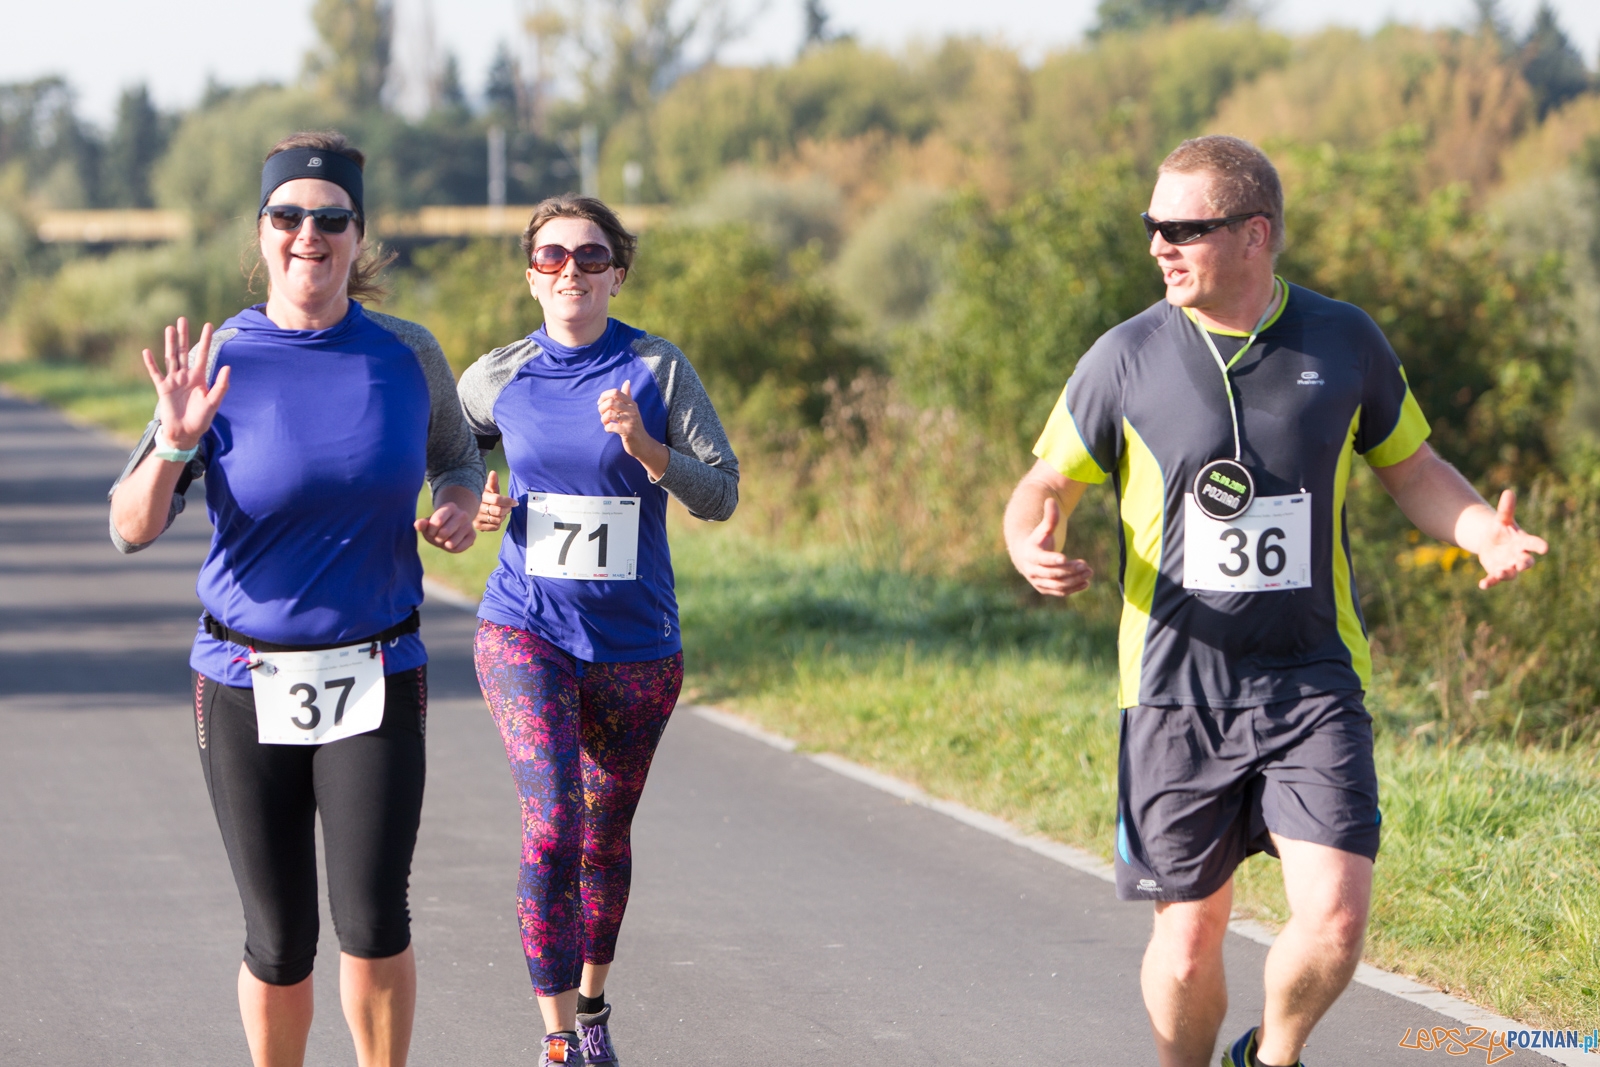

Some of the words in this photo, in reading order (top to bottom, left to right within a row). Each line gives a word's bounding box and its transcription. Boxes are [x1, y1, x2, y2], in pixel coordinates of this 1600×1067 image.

[554, 521, 609, 568] 71
[1218, 526, 1287, 577] 36
[288, 676, 356, 731] 37
